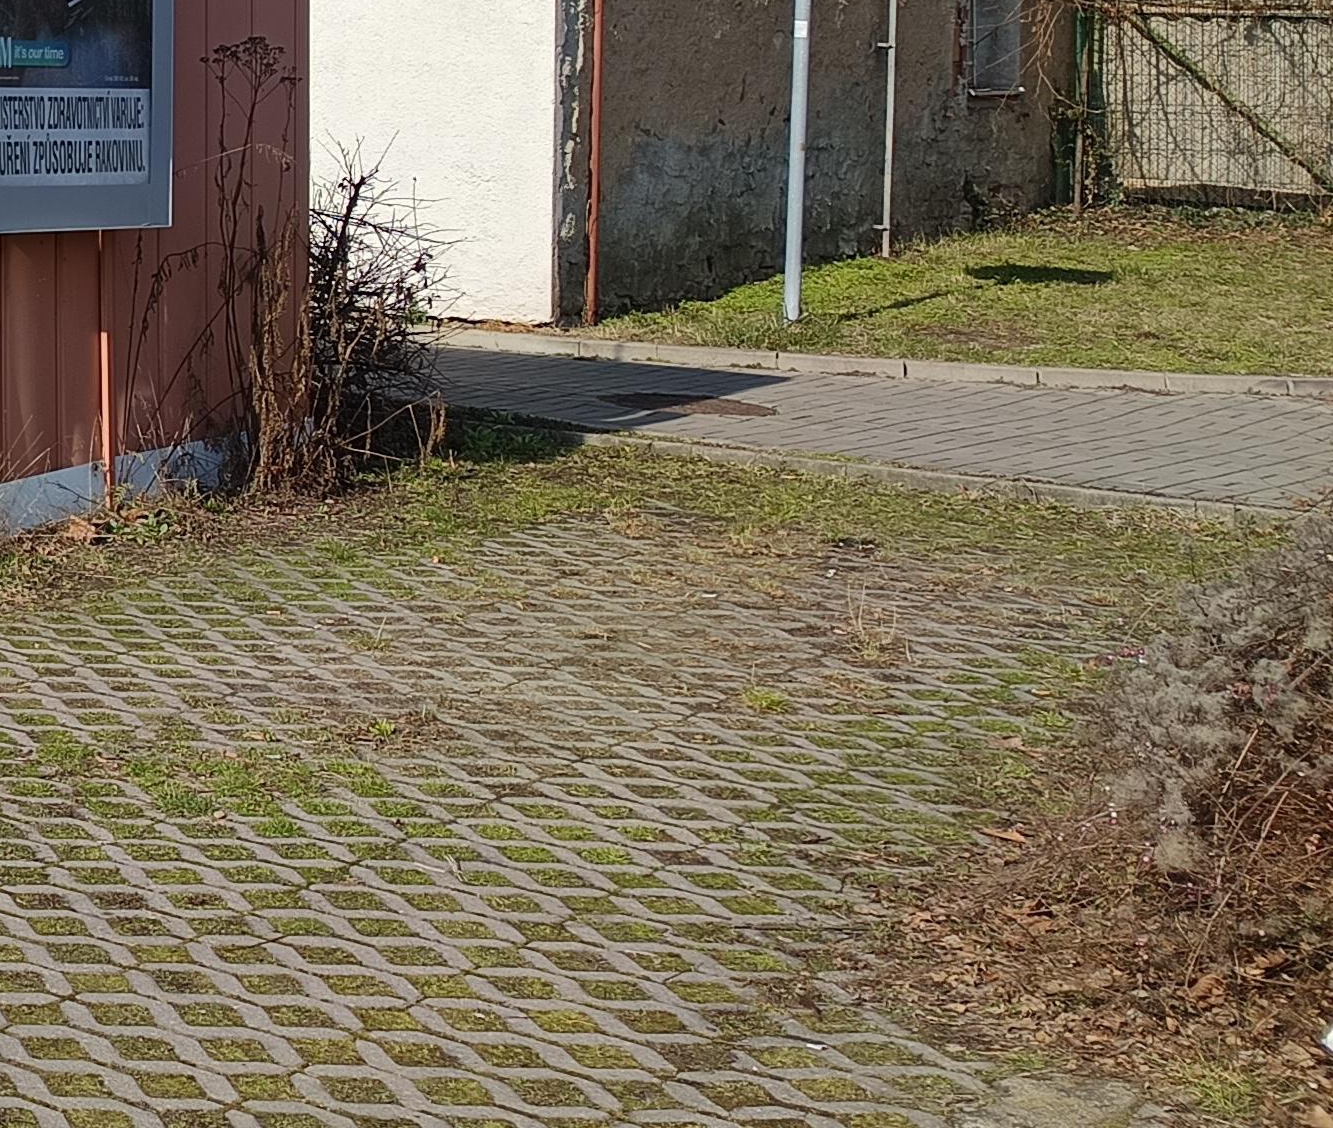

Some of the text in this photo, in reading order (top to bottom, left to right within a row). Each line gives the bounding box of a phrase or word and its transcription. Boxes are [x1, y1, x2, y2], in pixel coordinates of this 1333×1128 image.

[14, 45, 27, 59] it's
[28, 49, 44, 59] our
[44, 46, 64, 60] time
[47, 91, 110, 130] ZDRAVOTNICTVÍ
[112, 96, 145, 129] VARUJE:
[33, 133, 93, 175] ZPŮSOBUJE
[95, 140, 146, 172] RAKOVINU.
